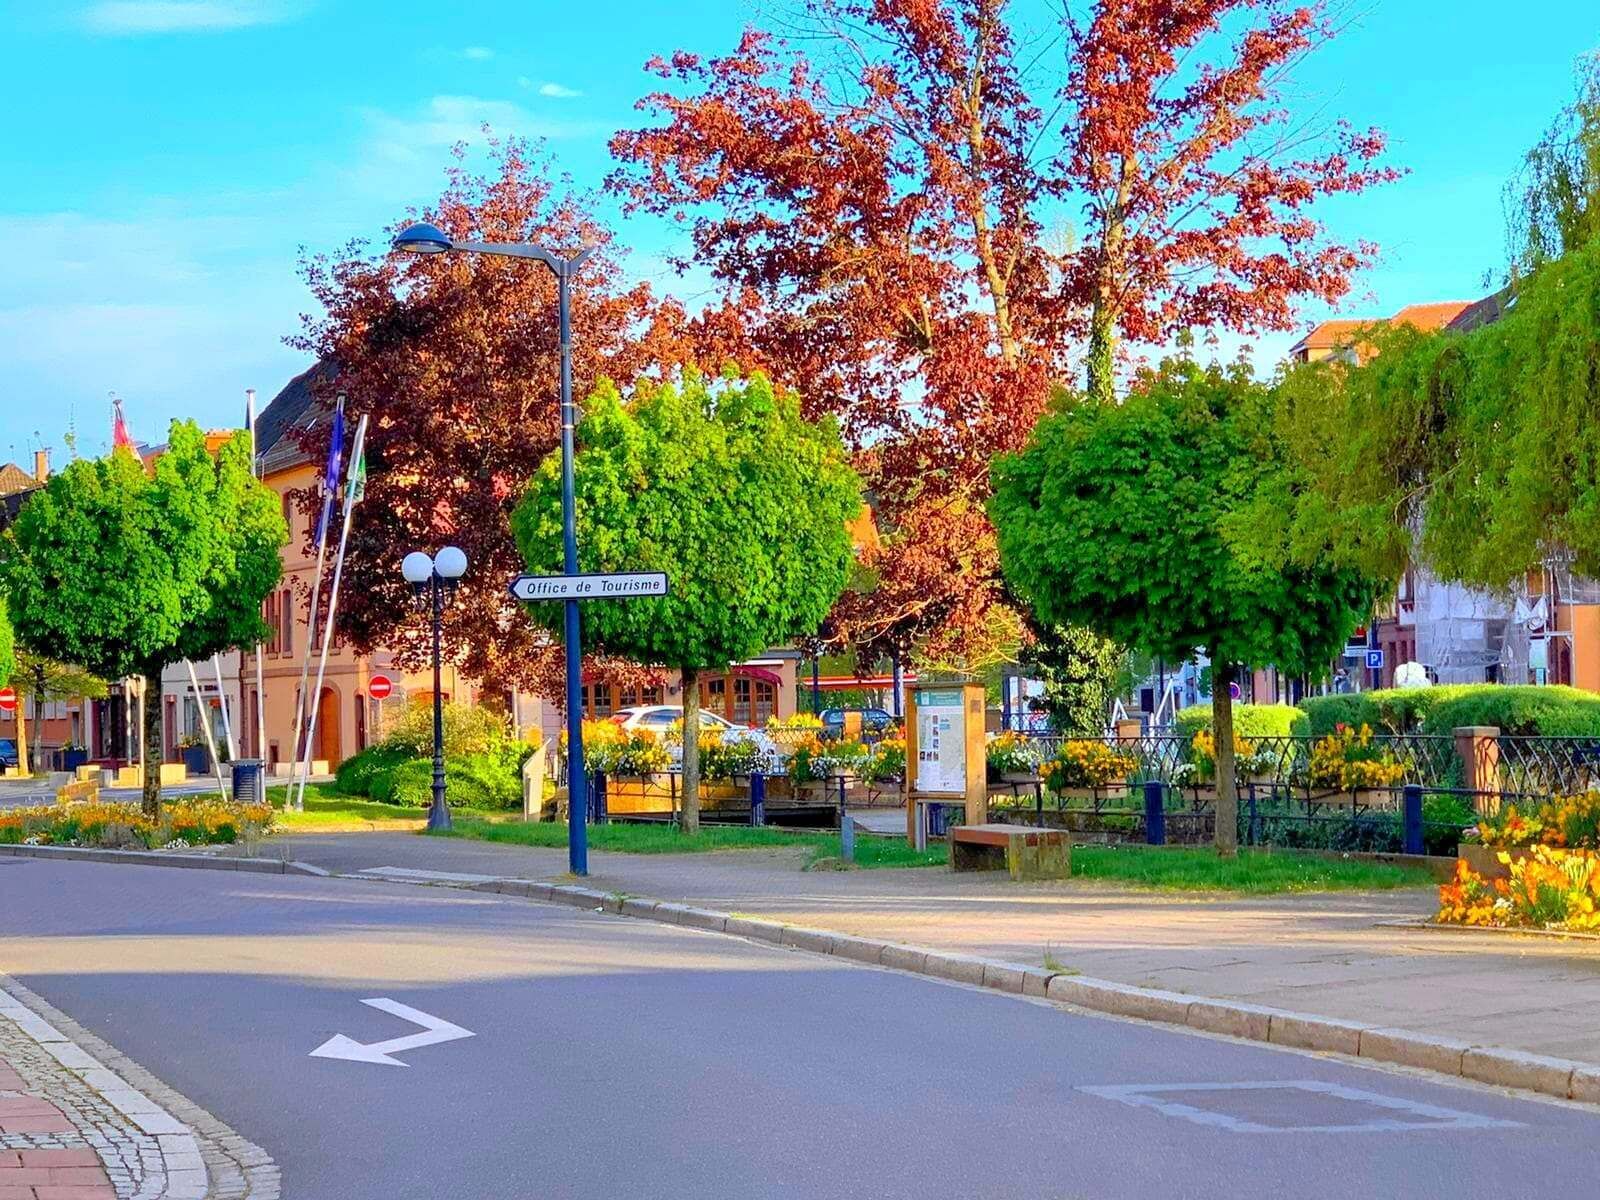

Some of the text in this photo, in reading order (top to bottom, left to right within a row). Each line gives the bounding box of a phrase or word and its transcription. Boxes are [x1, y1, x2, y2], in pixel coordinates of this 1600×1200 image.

[527, 579, 660, 594] Office de Tourisme
[1370, 653, 1379, 665] P
